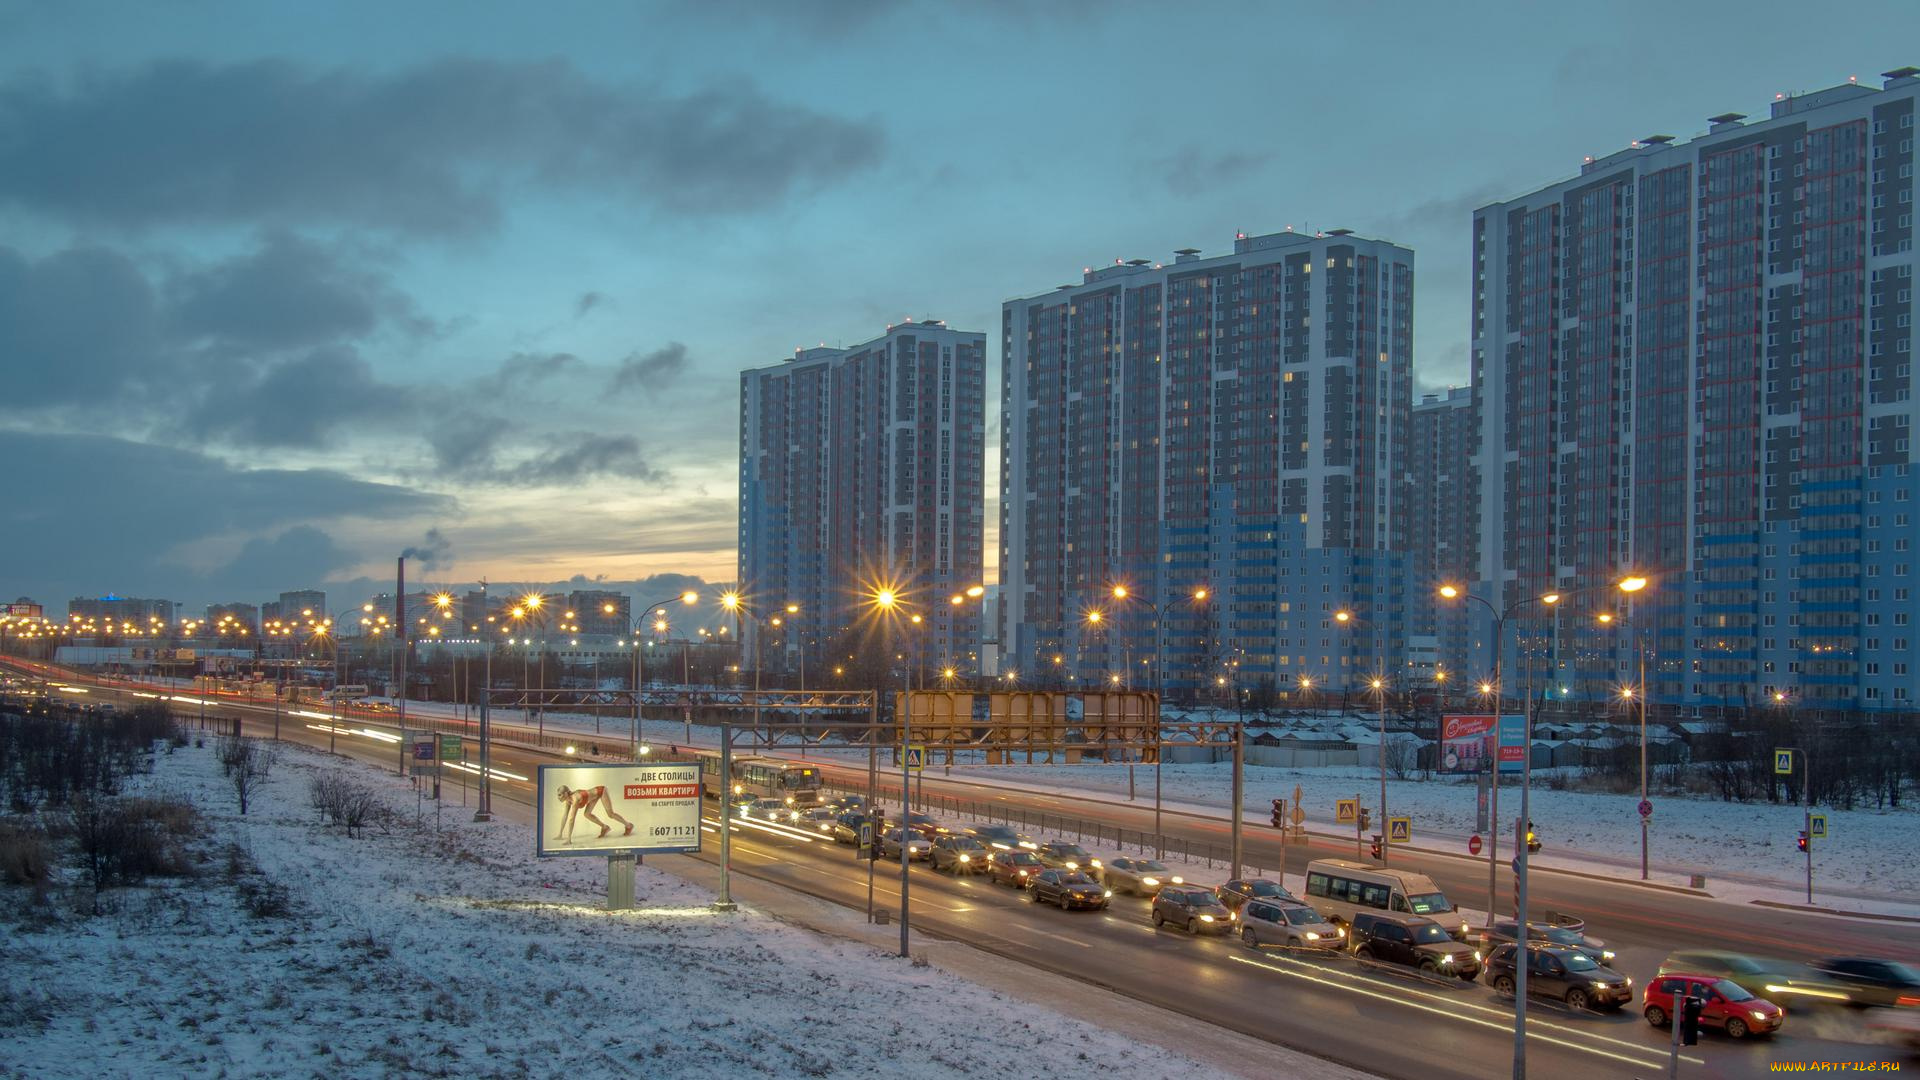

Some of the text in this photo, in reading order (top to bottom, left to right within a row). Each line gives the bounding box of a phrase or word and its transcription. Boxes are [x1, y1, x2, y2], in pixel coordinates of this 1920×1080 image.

[641, 772, 656, 782] ДВЕ
[658, 772, 694, 781] СТОЛИЦЫ
[628, 786, 696, 796] ВОЗЬМИ КВАРТИРУ
[654, 826, 671, 836] 607
[673, 826, 683, 835] 11
[686, 826, 695, 835] 21
